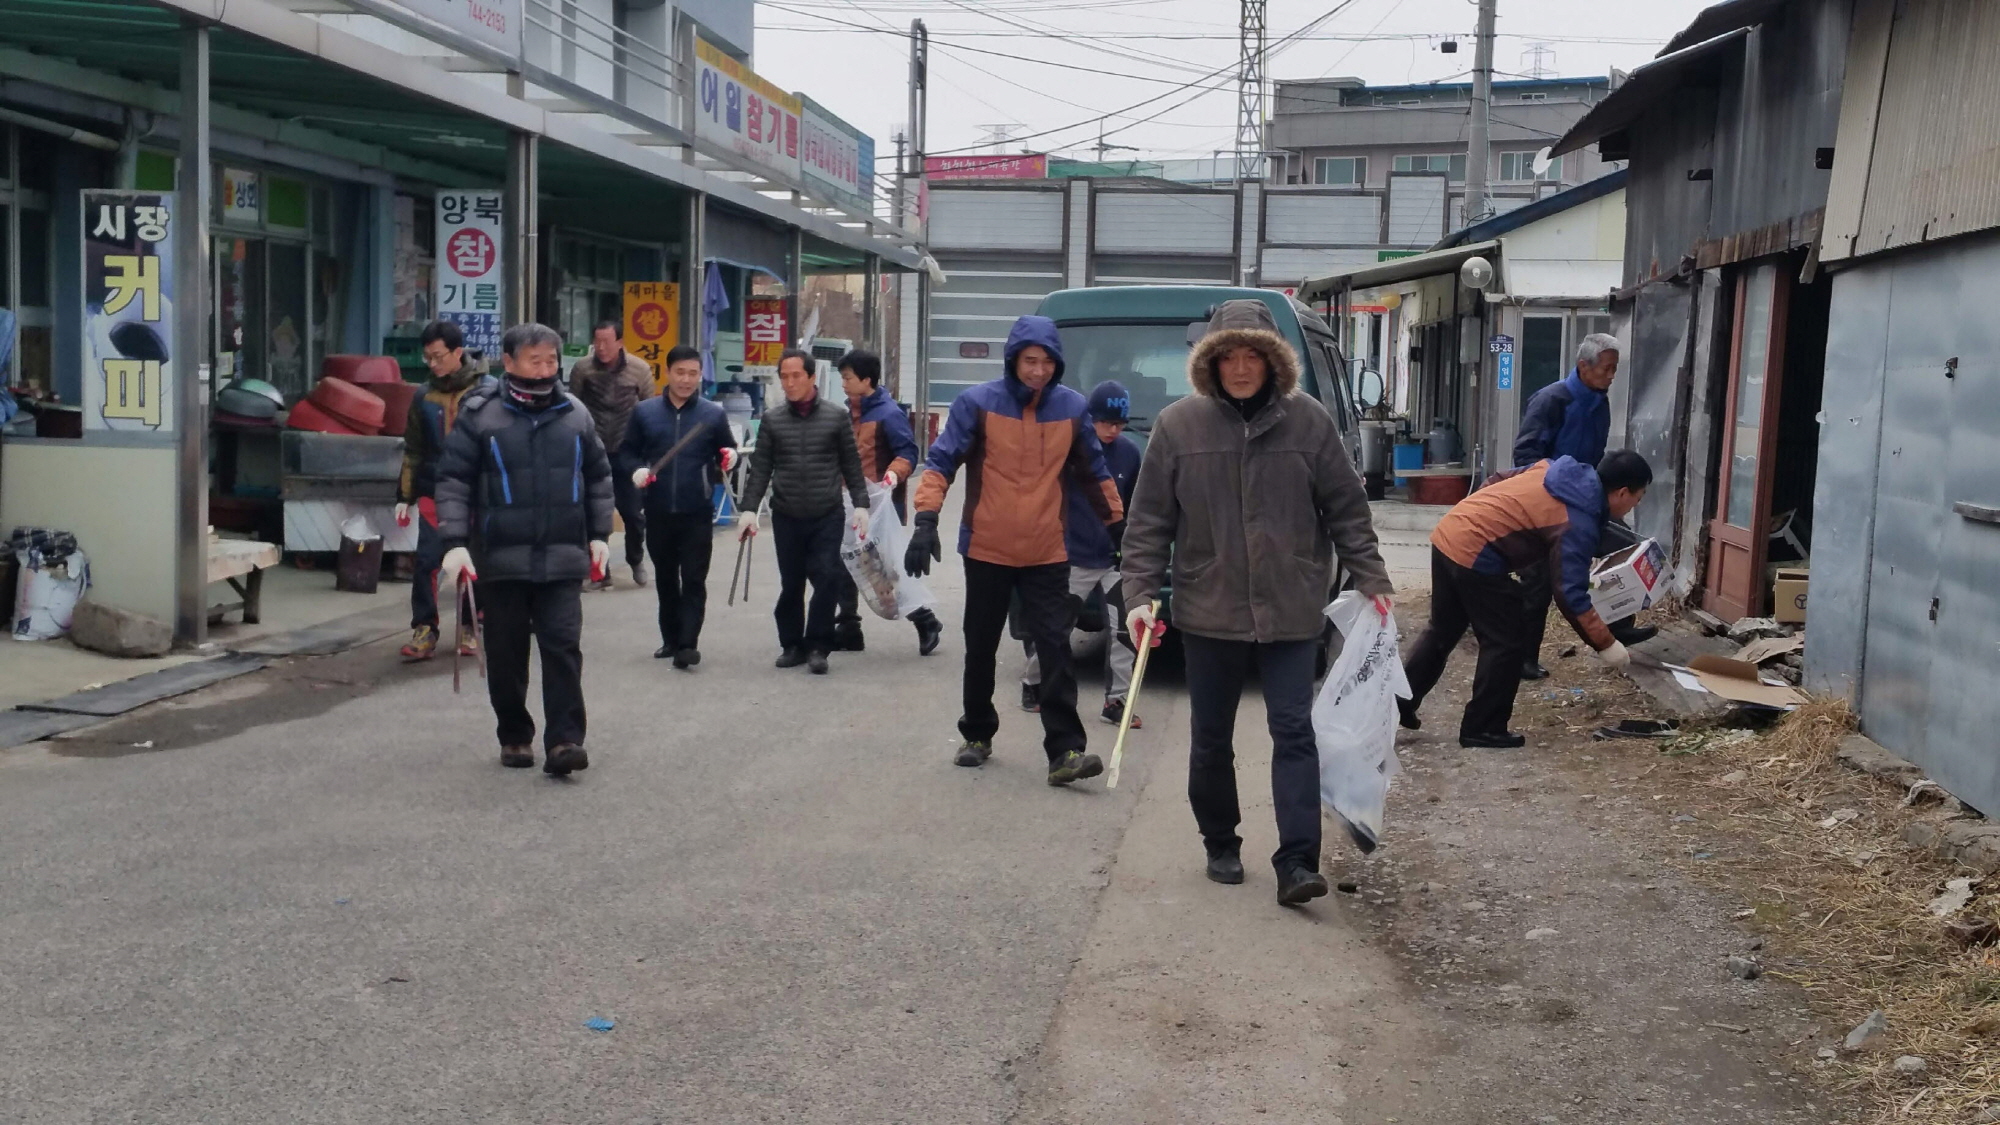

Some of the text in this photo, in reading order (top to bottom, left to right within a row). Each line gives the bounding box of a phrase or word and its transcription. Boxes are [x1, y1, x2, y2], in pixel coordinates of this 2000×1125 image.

[747, 93, 798, 159] 참기름
[93, 205, 169, 241] 시장
[441, 195, 501, 225] 양북
[453, 235, 490, 273] 참
[443, 283, 499, 310] 기름
[628, 284, 675, 300] 새마을
[103, 254, 161, 426] 커피
[747, 313, 786, 341] 참
[1490, 343, 1513, 352] 53-28
[1501, 356, 1510, 386] 영업중
